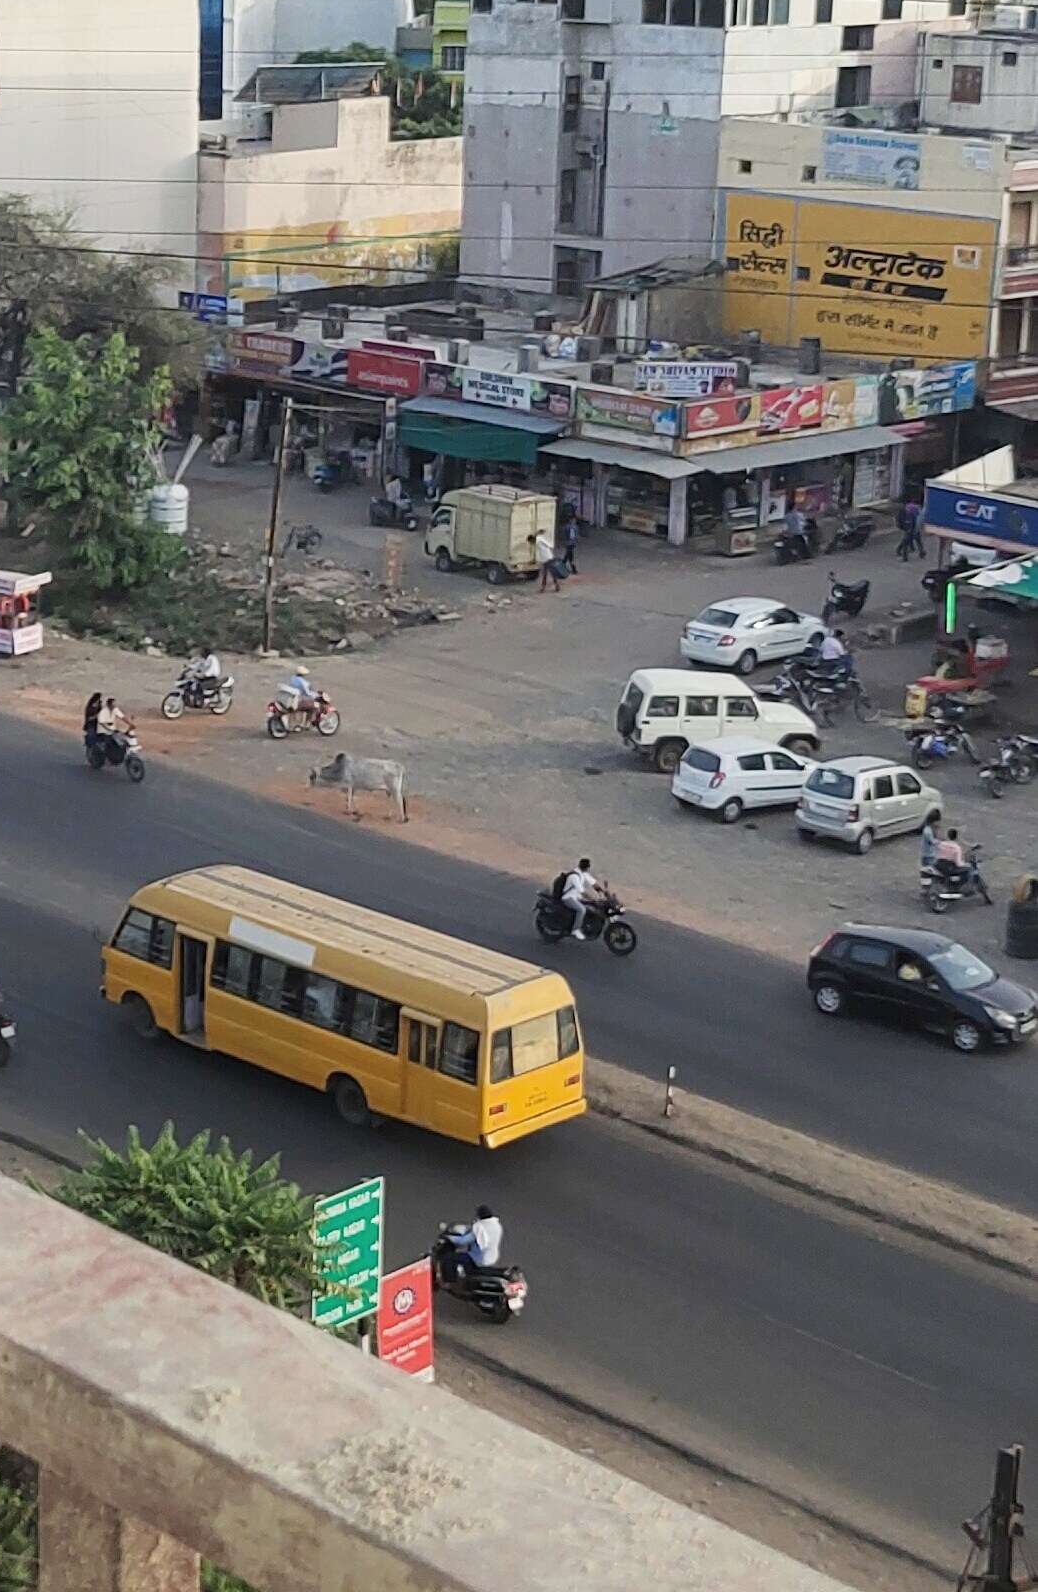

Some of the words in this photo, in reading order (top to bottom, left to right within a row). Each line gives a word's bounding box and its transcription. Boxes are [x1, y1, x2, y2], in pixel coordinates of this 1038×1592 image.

[824, 245, 947, 280] अल्ट्राटेक
[700, 365, 736, 376] STUDIO
[468, 379, 500, 395] MEDICAL
[955, 500, 998, 520] CEAT
